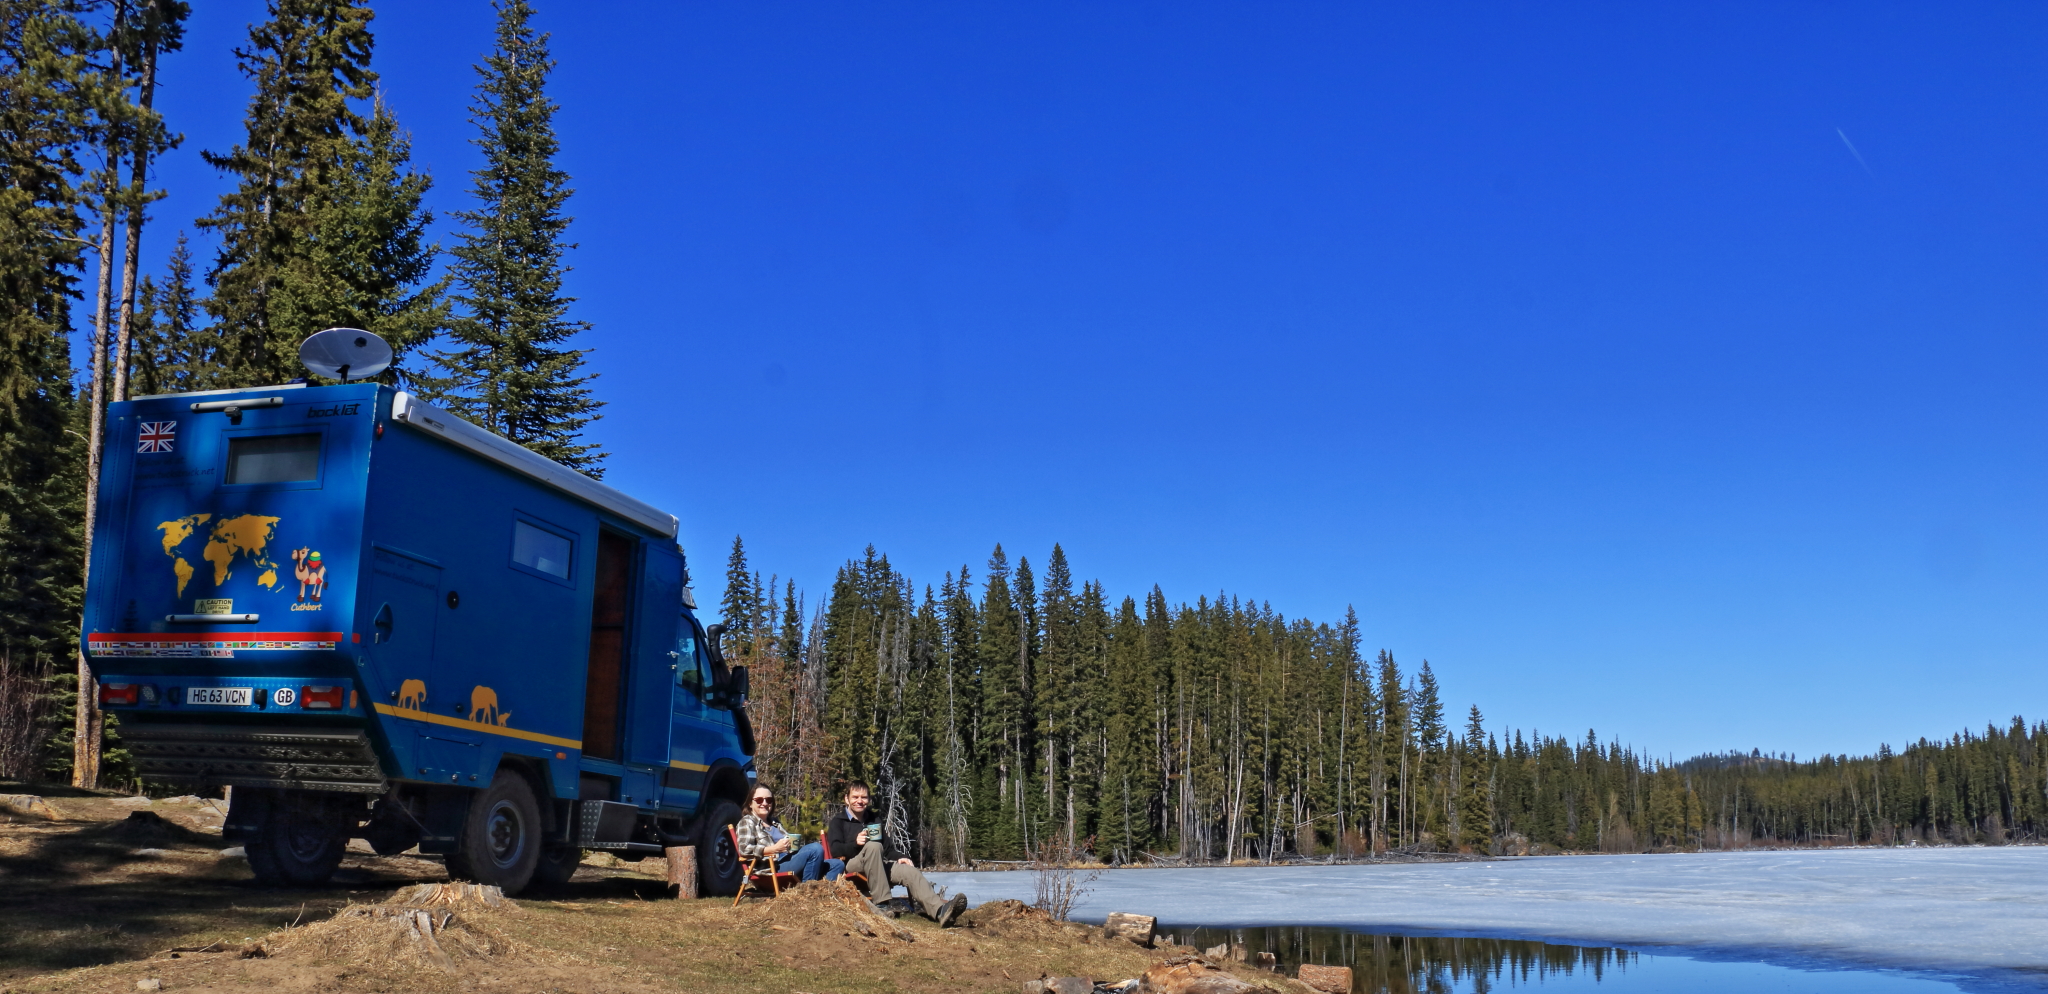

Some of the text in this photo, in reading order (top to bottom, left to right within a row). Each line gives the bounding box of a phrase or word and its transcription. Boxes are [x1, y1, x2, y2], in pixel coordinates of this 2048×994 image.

[290, 602, 323, 612] Cuthbert
[192, 690, 246, 703] HG 63 VCN
[277, 691, 293, 703] GB
